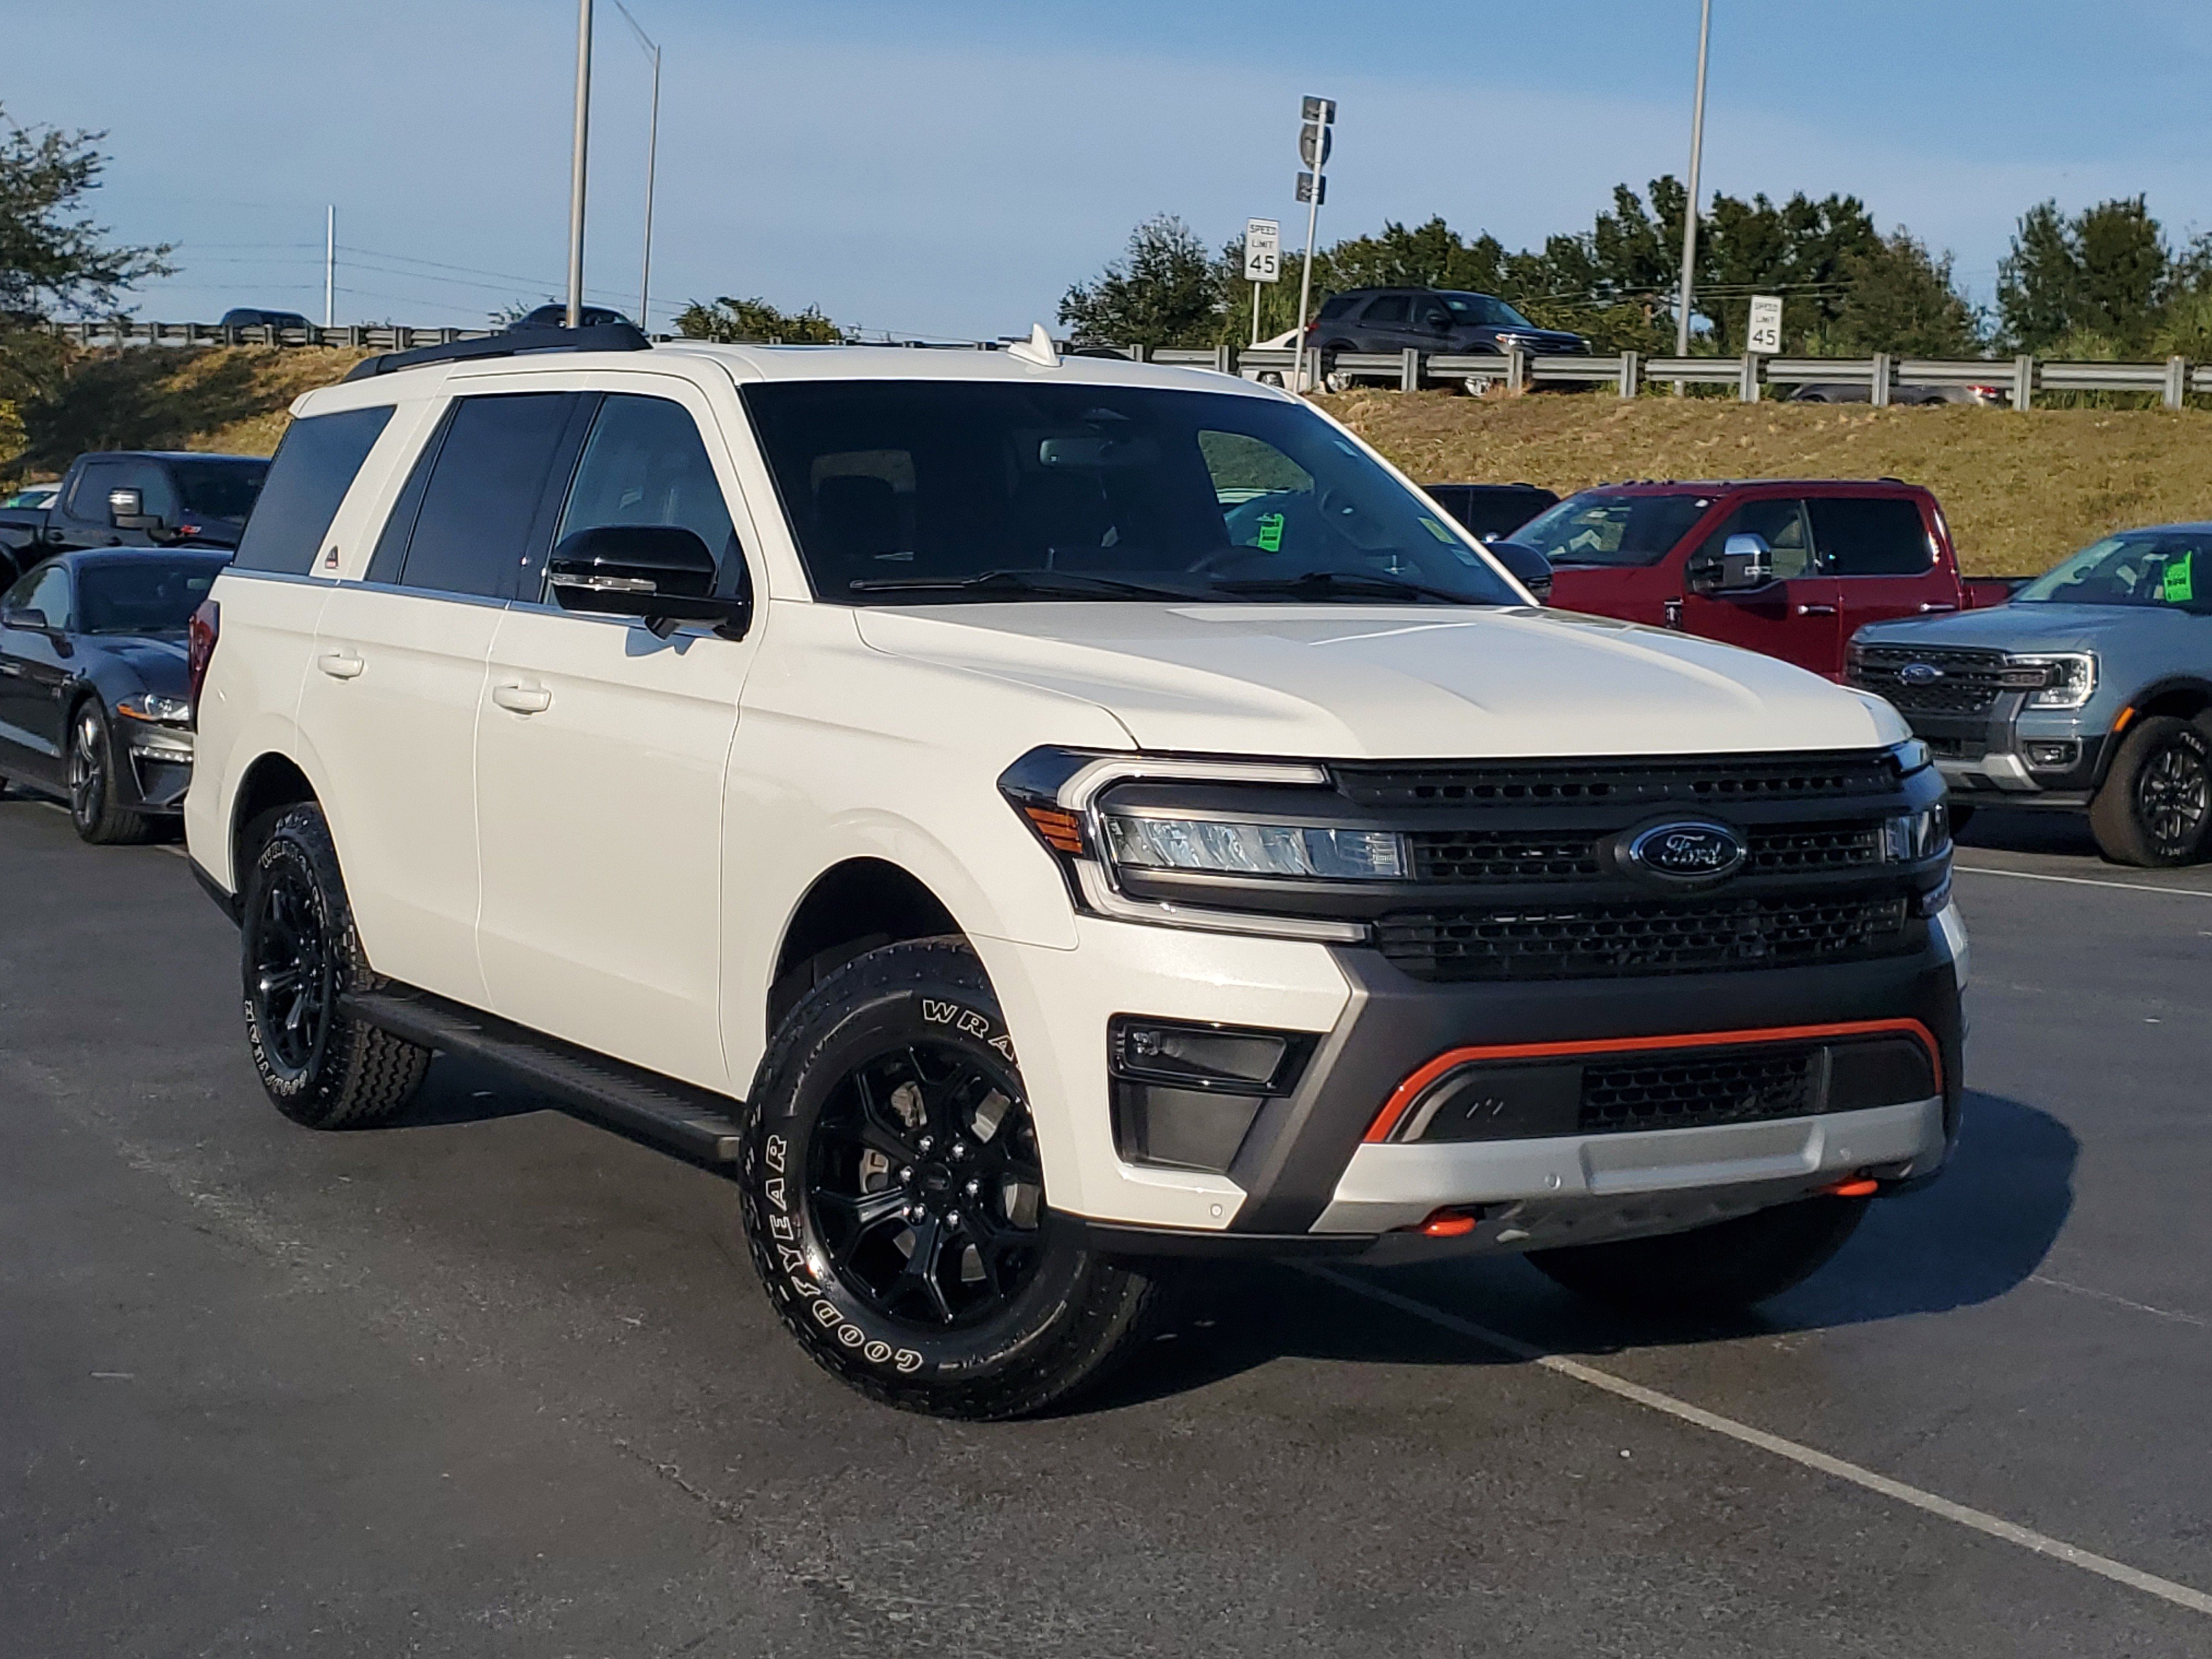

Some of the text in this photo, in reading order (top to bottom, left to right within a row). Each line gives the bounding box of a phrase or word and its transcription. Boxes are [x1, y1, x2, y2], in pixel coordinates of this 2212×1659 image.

[1250, 254, 1274, 273] 45
[1752, 329, 1776, 346] 45
[1661, 834, 1722, 866] Ford
[923, 999, 1021, 1070] WRA
[765, 1135, 924, 1373] GOODYEAR
